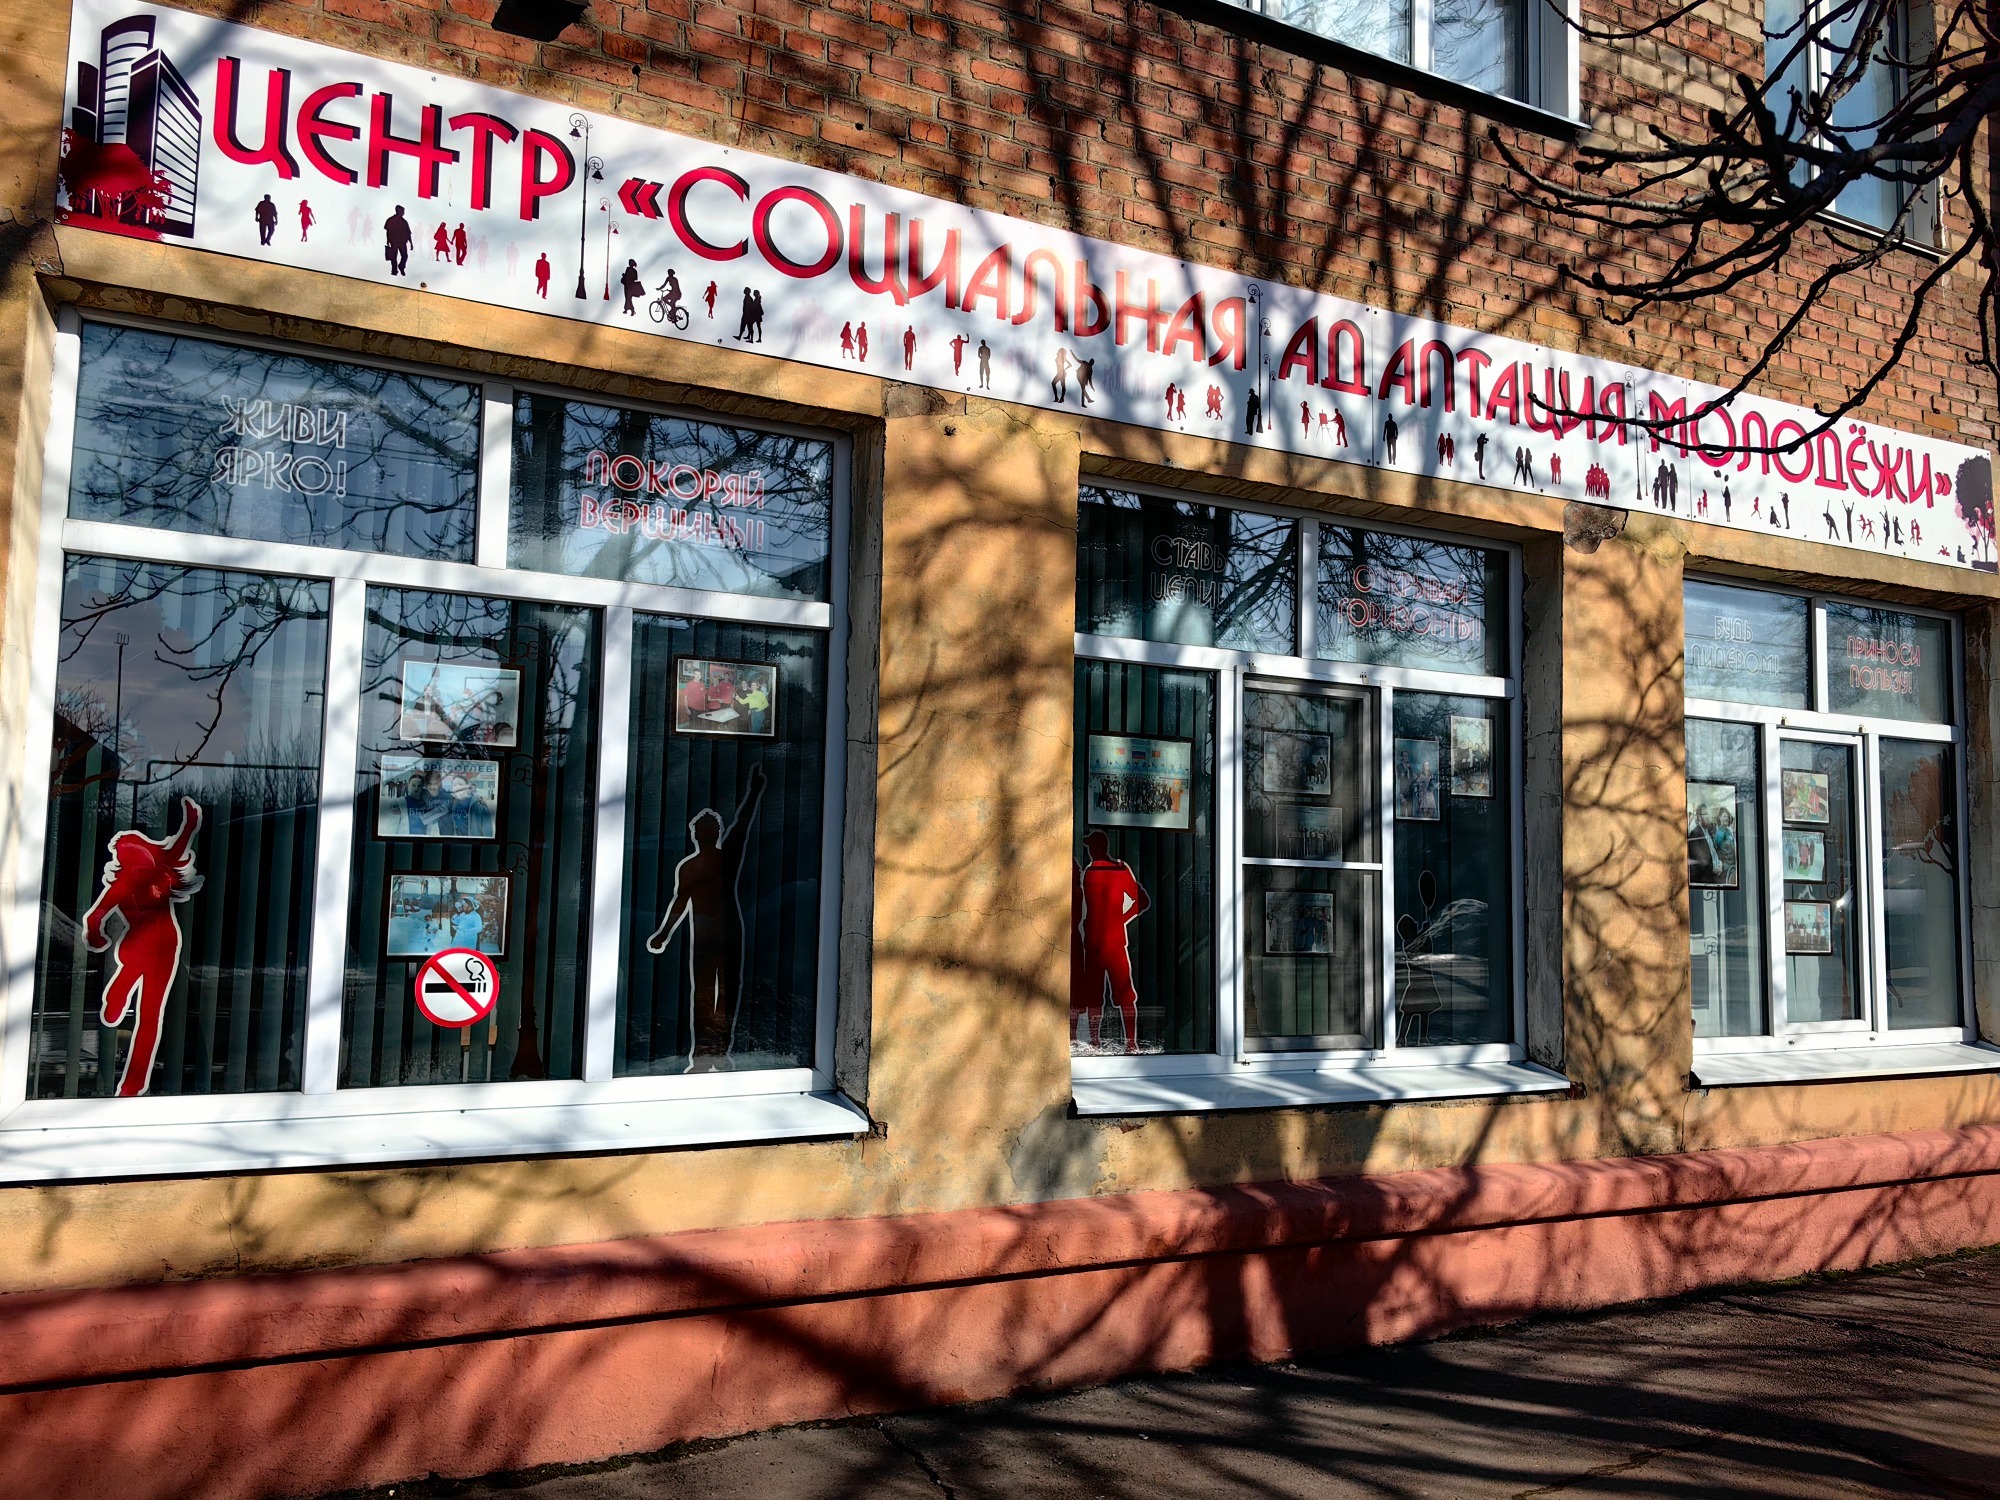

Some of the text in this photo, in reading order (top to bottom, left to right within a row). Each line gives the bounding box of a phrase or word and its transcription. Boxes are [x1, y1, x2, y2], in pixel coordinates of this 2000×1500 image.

[213, 55, 1952, 508] ЦЕНТР «СОЦИАЛЬНАЯ АДАПТАЦИЯ МОЛОДЁЖИ»
[219, 395, 346, 448] ЖИВИ
[211, 446, 346, 497] ЯРКО!
[585, 450, 765, 510] ПОКОРЯЙ
[580, 494, 765, 552] ВЕРШИНЫ!
[1151, 534, 1228, 573] СТАВЬ
[1353, 565, 1468, 606] ОТКРЫВАЙ
[1338, 597, 1482, 642] ГОРИЗОНТЫ!
[1714, 615, 1754, 643] БУДЬ
[1691, 643, 1780, 677] ЛИДЕРОМ!
[1846, 635, 1921, 667] ПРИНОСИ
[1850, 665, 1914, 694] ПОЛЬЗУ!
